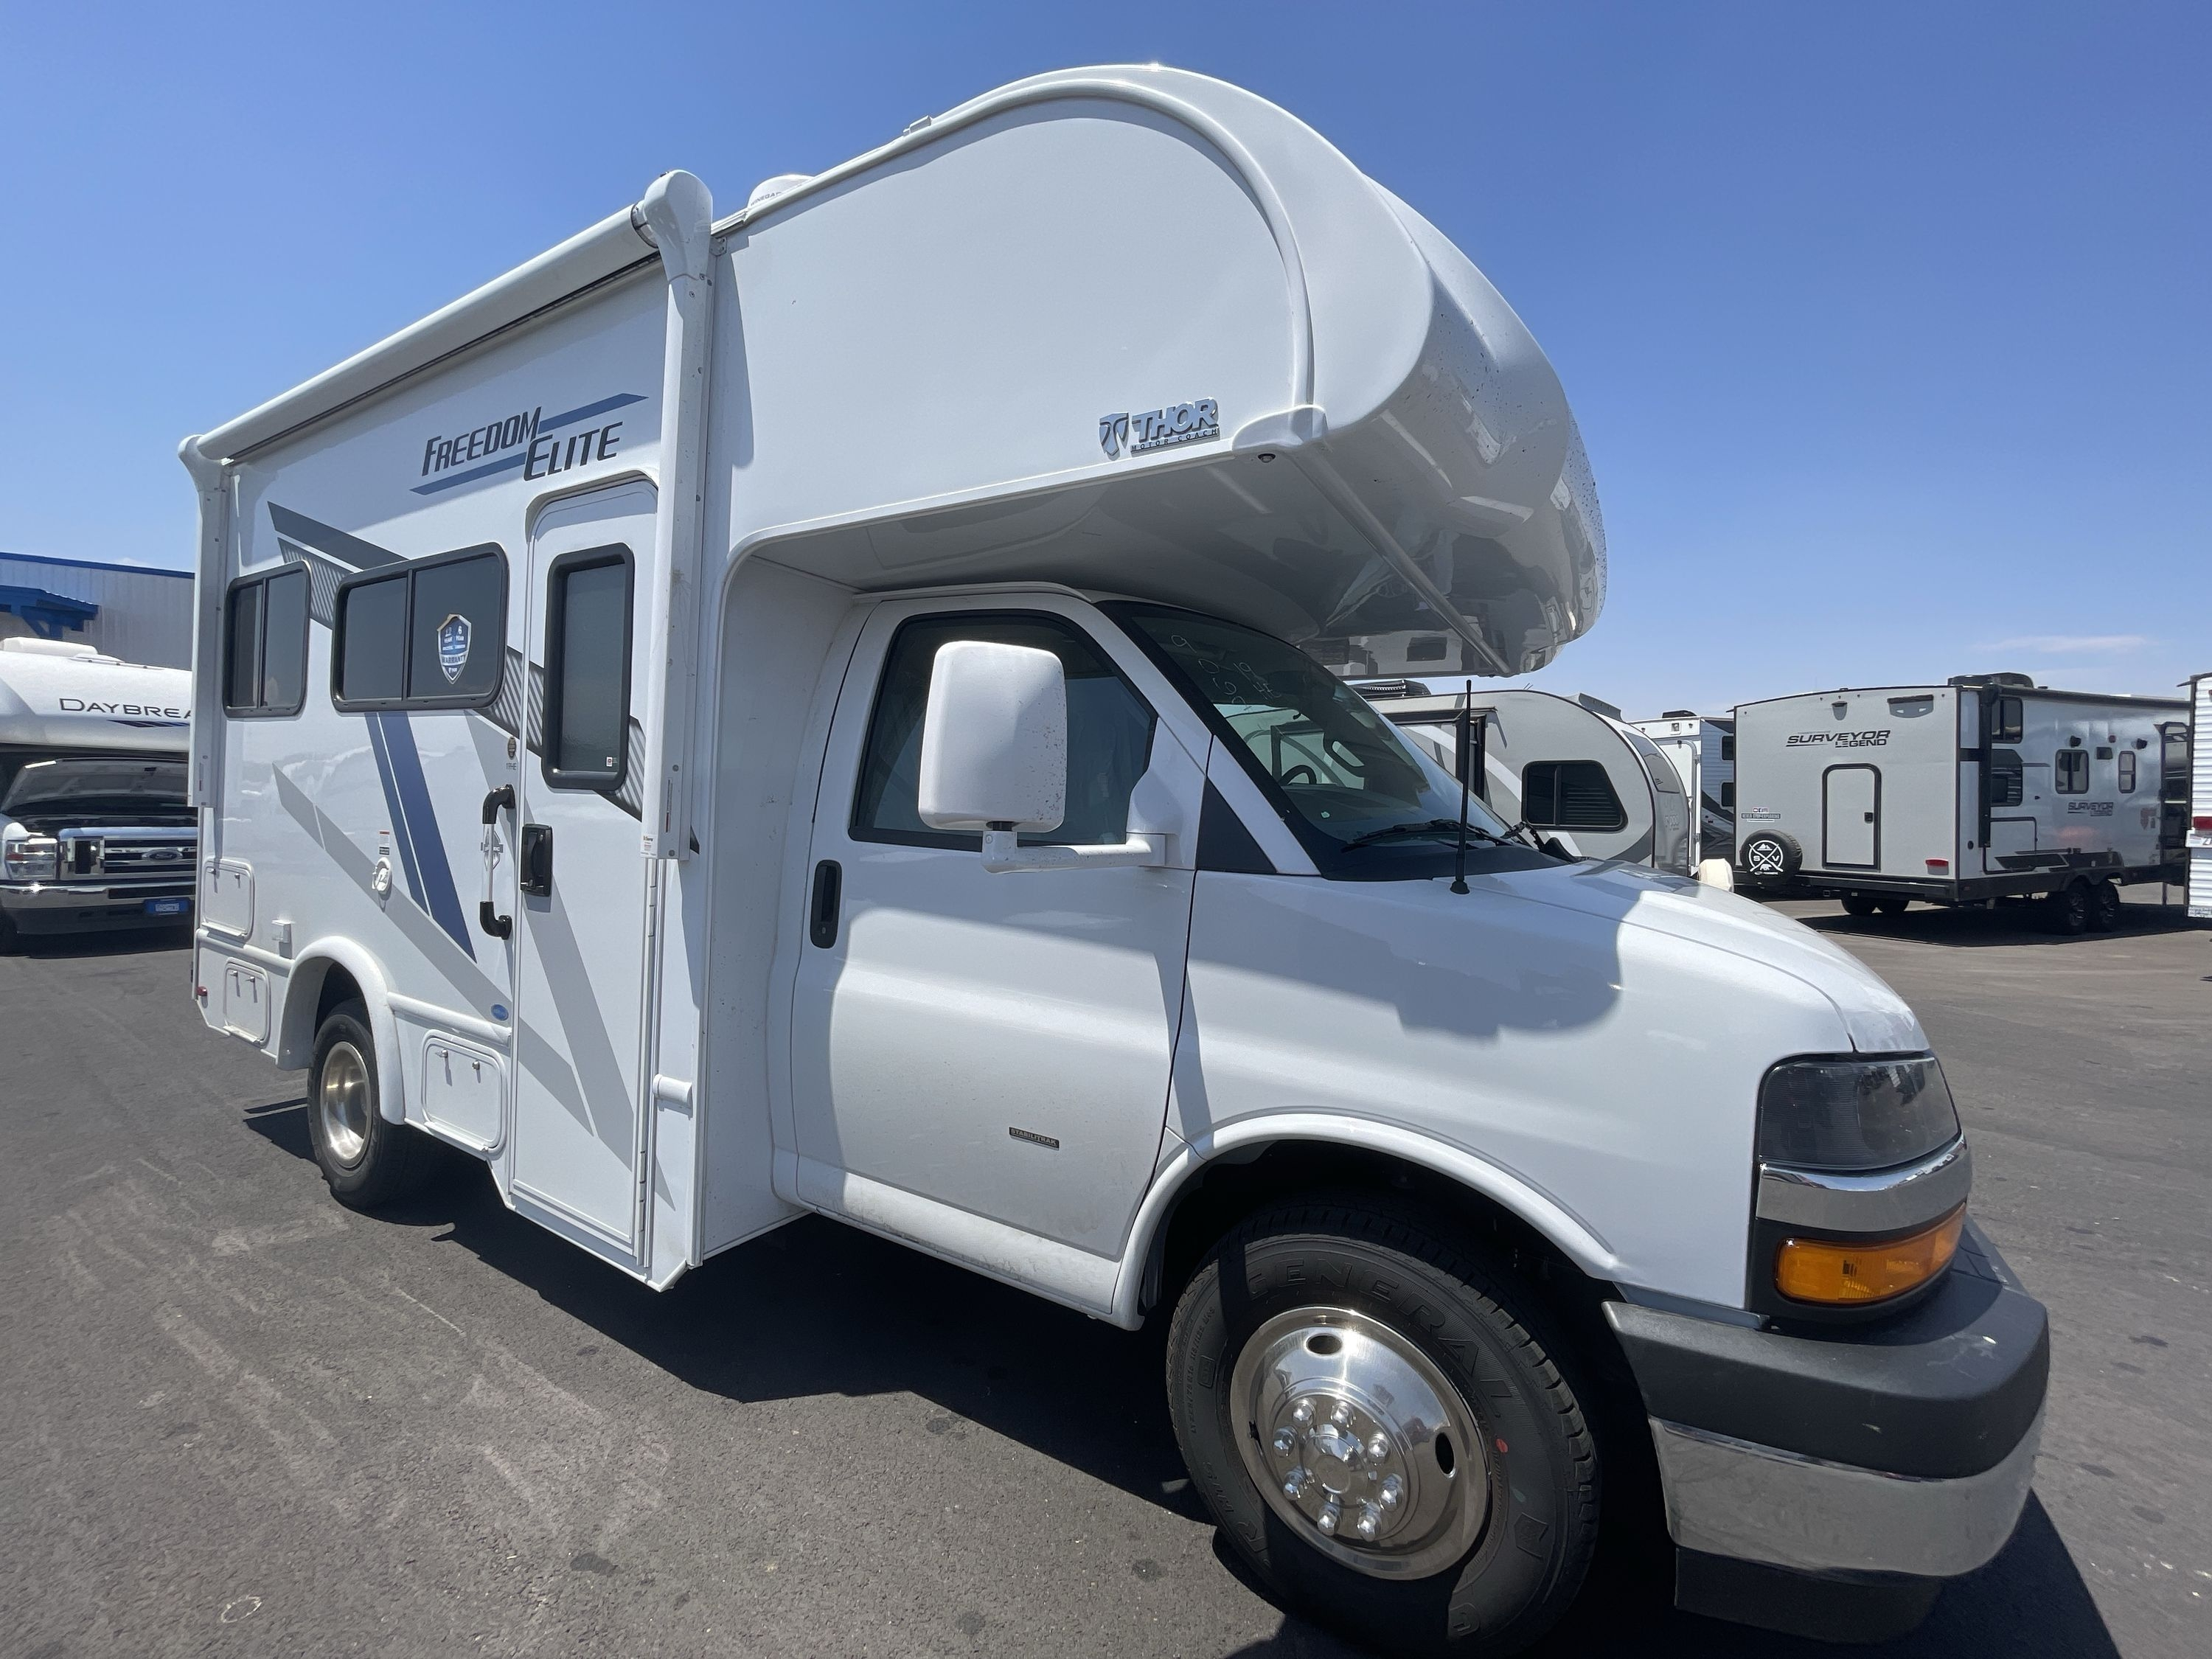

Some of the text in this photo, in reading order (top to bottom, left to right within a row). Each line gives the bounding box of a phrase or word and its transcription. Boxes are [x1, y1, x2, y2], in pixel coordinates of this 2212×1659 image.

[1132, 397, 1219, 443] THOR
[422, 406, 542, 476] FREEDOM
[523, 421, 623, 481] ELITE
[1131, 429, 1218, 452] MOTOR COACH
[1787, 730, 1891, 744] SURVEYOR
[1835, 739, 1887, 748] LEGEND
[1011, 1128, 1057, 1146] STABILITRAK
[1247, 1258, 1514, 1418] GENERAL
